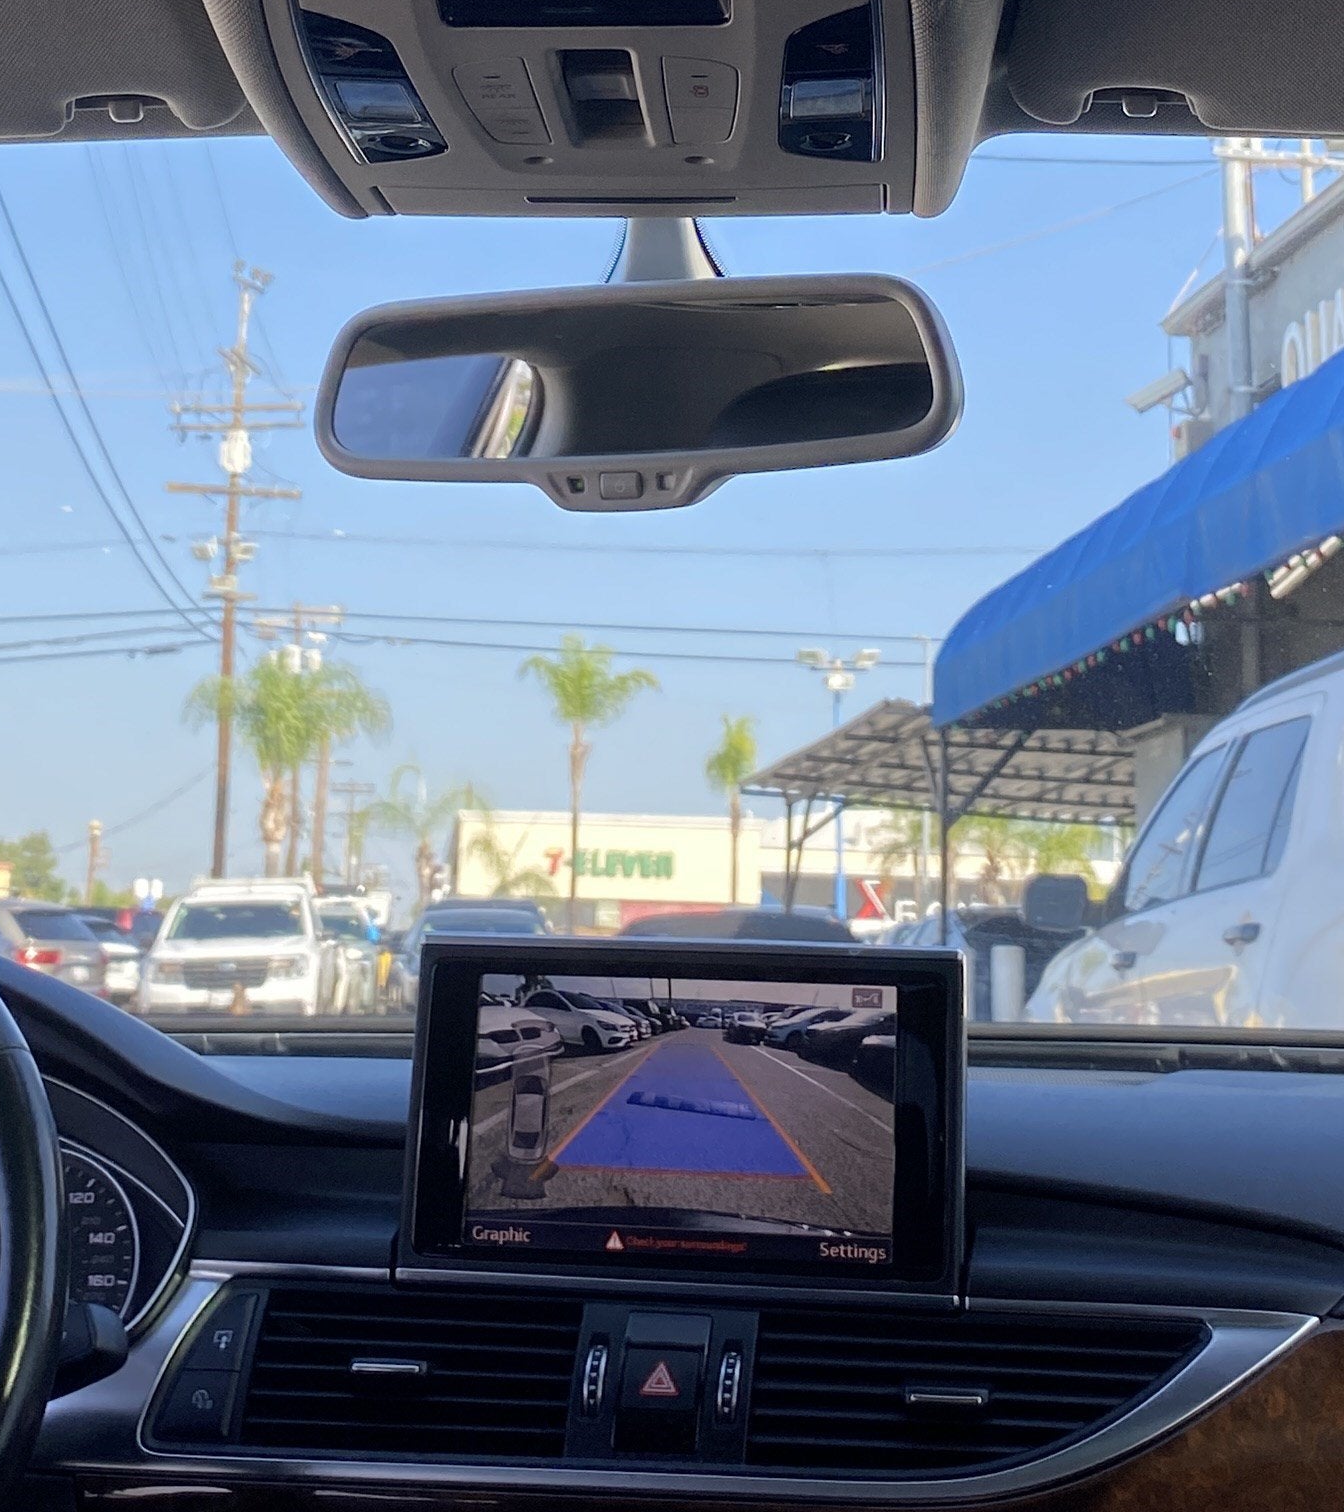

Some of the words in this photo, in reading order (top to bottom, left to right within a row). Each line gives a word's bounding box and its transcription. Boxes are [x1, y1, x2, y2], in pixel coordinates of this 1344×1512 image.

[68, 1192, 95, 1204] 120
[88, 1232, 116, 1245] 140
[472, 1225, 532, 1245] Graphic
[819, 1241, 887, 1264] Settings
[87, 1275, 115, 1287] 160
